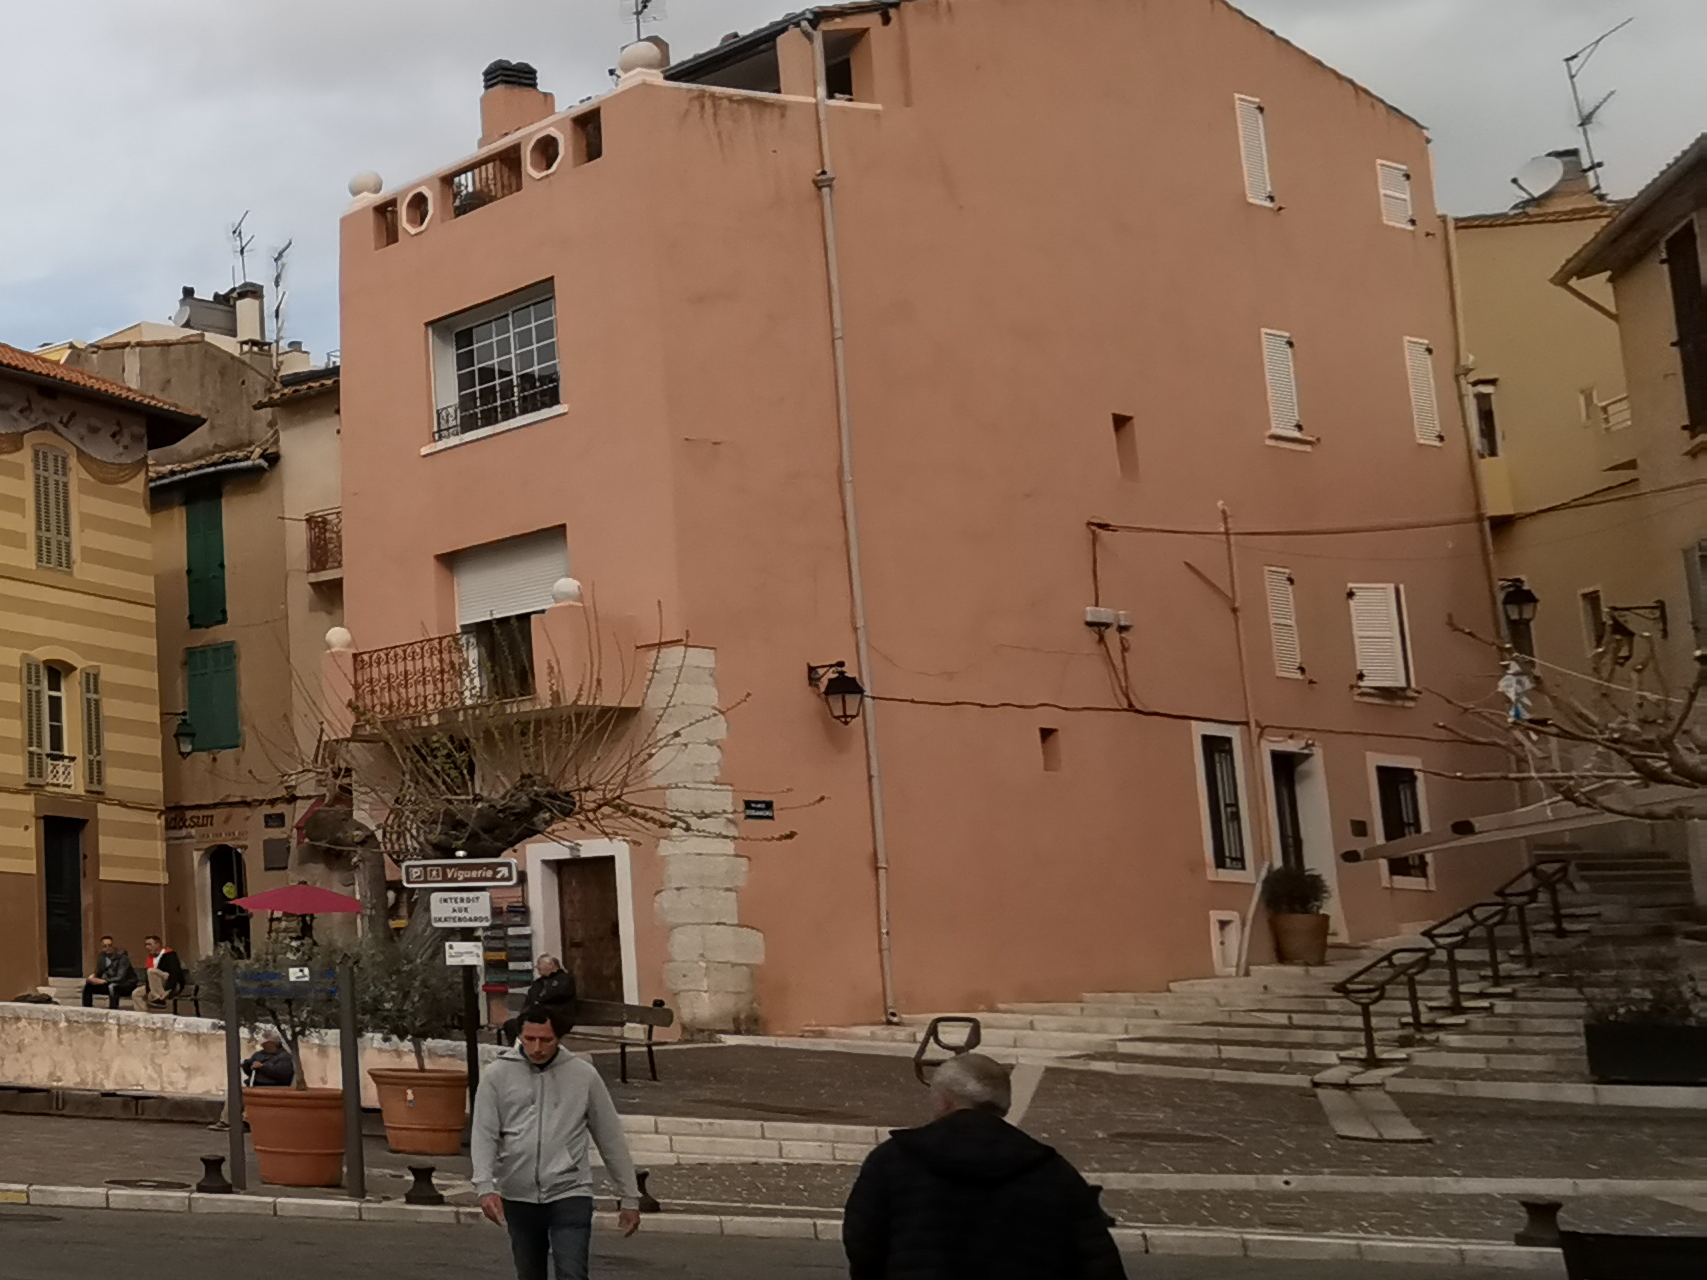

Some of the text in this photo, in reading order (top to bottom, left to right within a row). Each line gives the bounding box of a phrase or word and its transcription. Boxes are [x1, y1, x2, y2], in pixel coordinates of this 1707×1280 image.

[446, 867, 494, 880] Viguerie
[439, 896, 480, 904] INTERDIT
[433, 916, 490, 924] SKATEBOARDS
